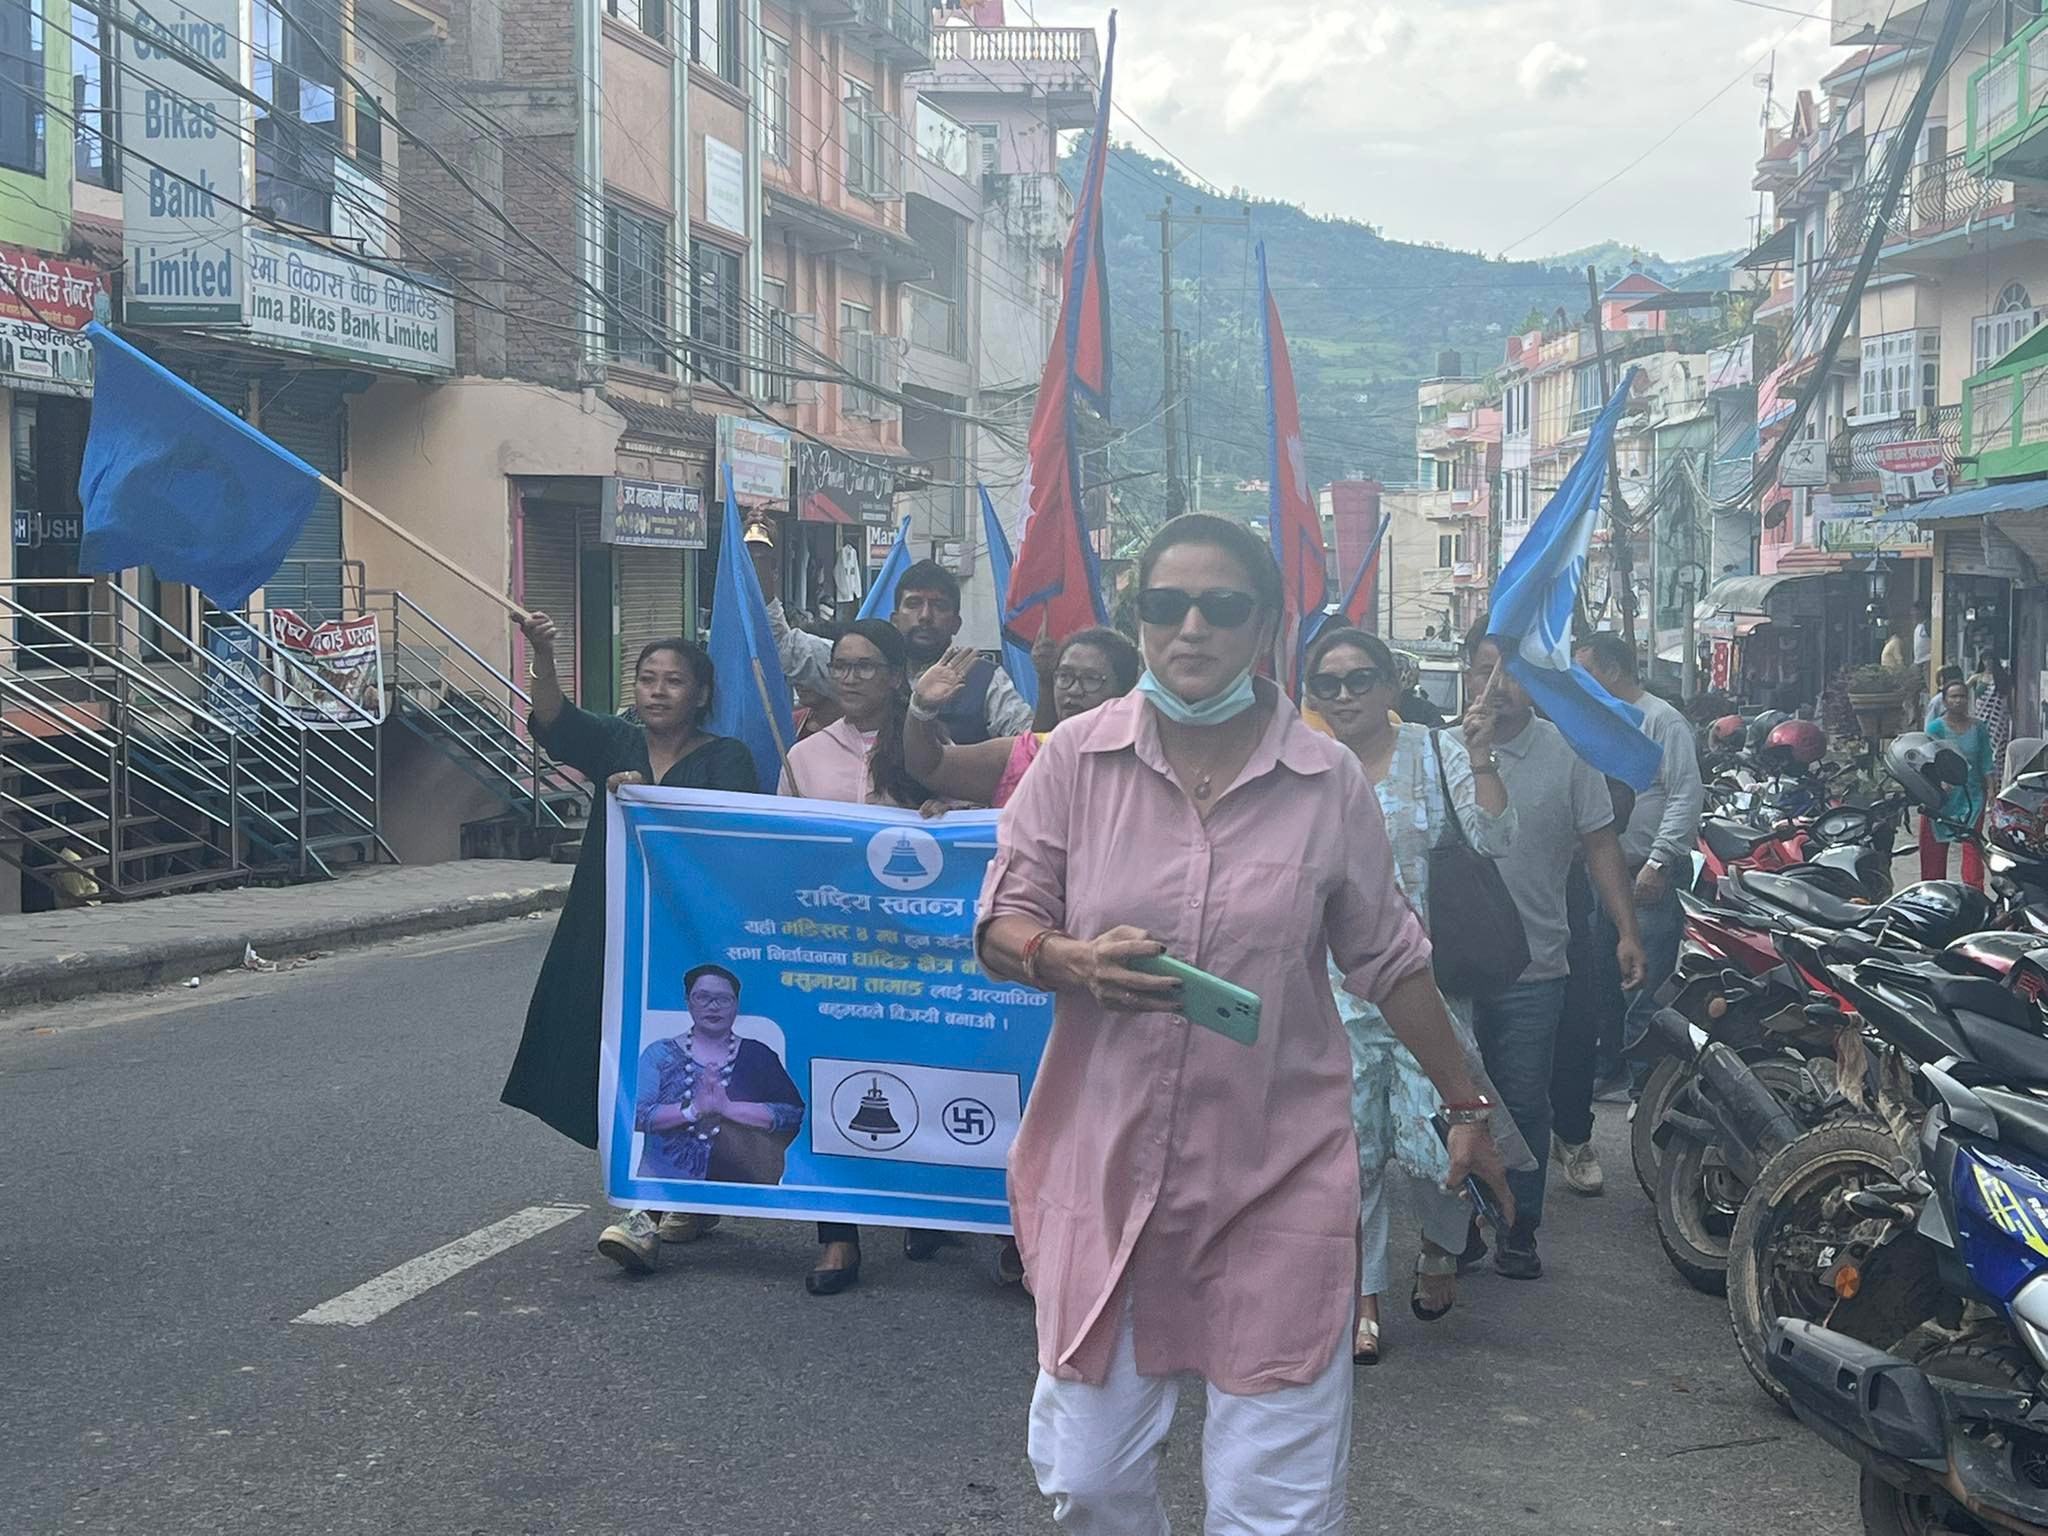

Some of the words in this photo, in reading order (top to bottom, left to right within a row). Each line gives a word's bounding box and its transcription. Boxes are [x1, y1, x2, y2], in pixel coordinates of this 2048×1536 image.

[133, 11, 226, 60] Garima
[145, 89, 217, 139] Bikas
[149, 168, 215, 218] Bank
[133, 247, 231, 297] Limited
[287, 252, 345, 300] विकास
[384, 278, 438, 321] लिमिटेड
[251, 287, 283, 322] ima
[289, 295, 336, 333] Bikas
[341, 306, 380, 342] Bank
[385, 316, 439, 354] Limited
[30, 519, 78, 538] PUSH
[793, 884, 871, 913] राष्ट्रिय
[879, 896, 965, 917] स्वतन्त्र
[744, 918, 776, 936] यही
[726, 946, 762, 961] सभा
[767, 945, 848, 966] निर्वाचनमा
[917, 953, 953, 974] क्षेत्र
[780, 970, 857, 992] बसुमाया
[864, 977, 923, 995] तामाङ
[967, 988, 1049, 1007] अत्याधिक
[889, 1003, 940, 1025] विजयी
